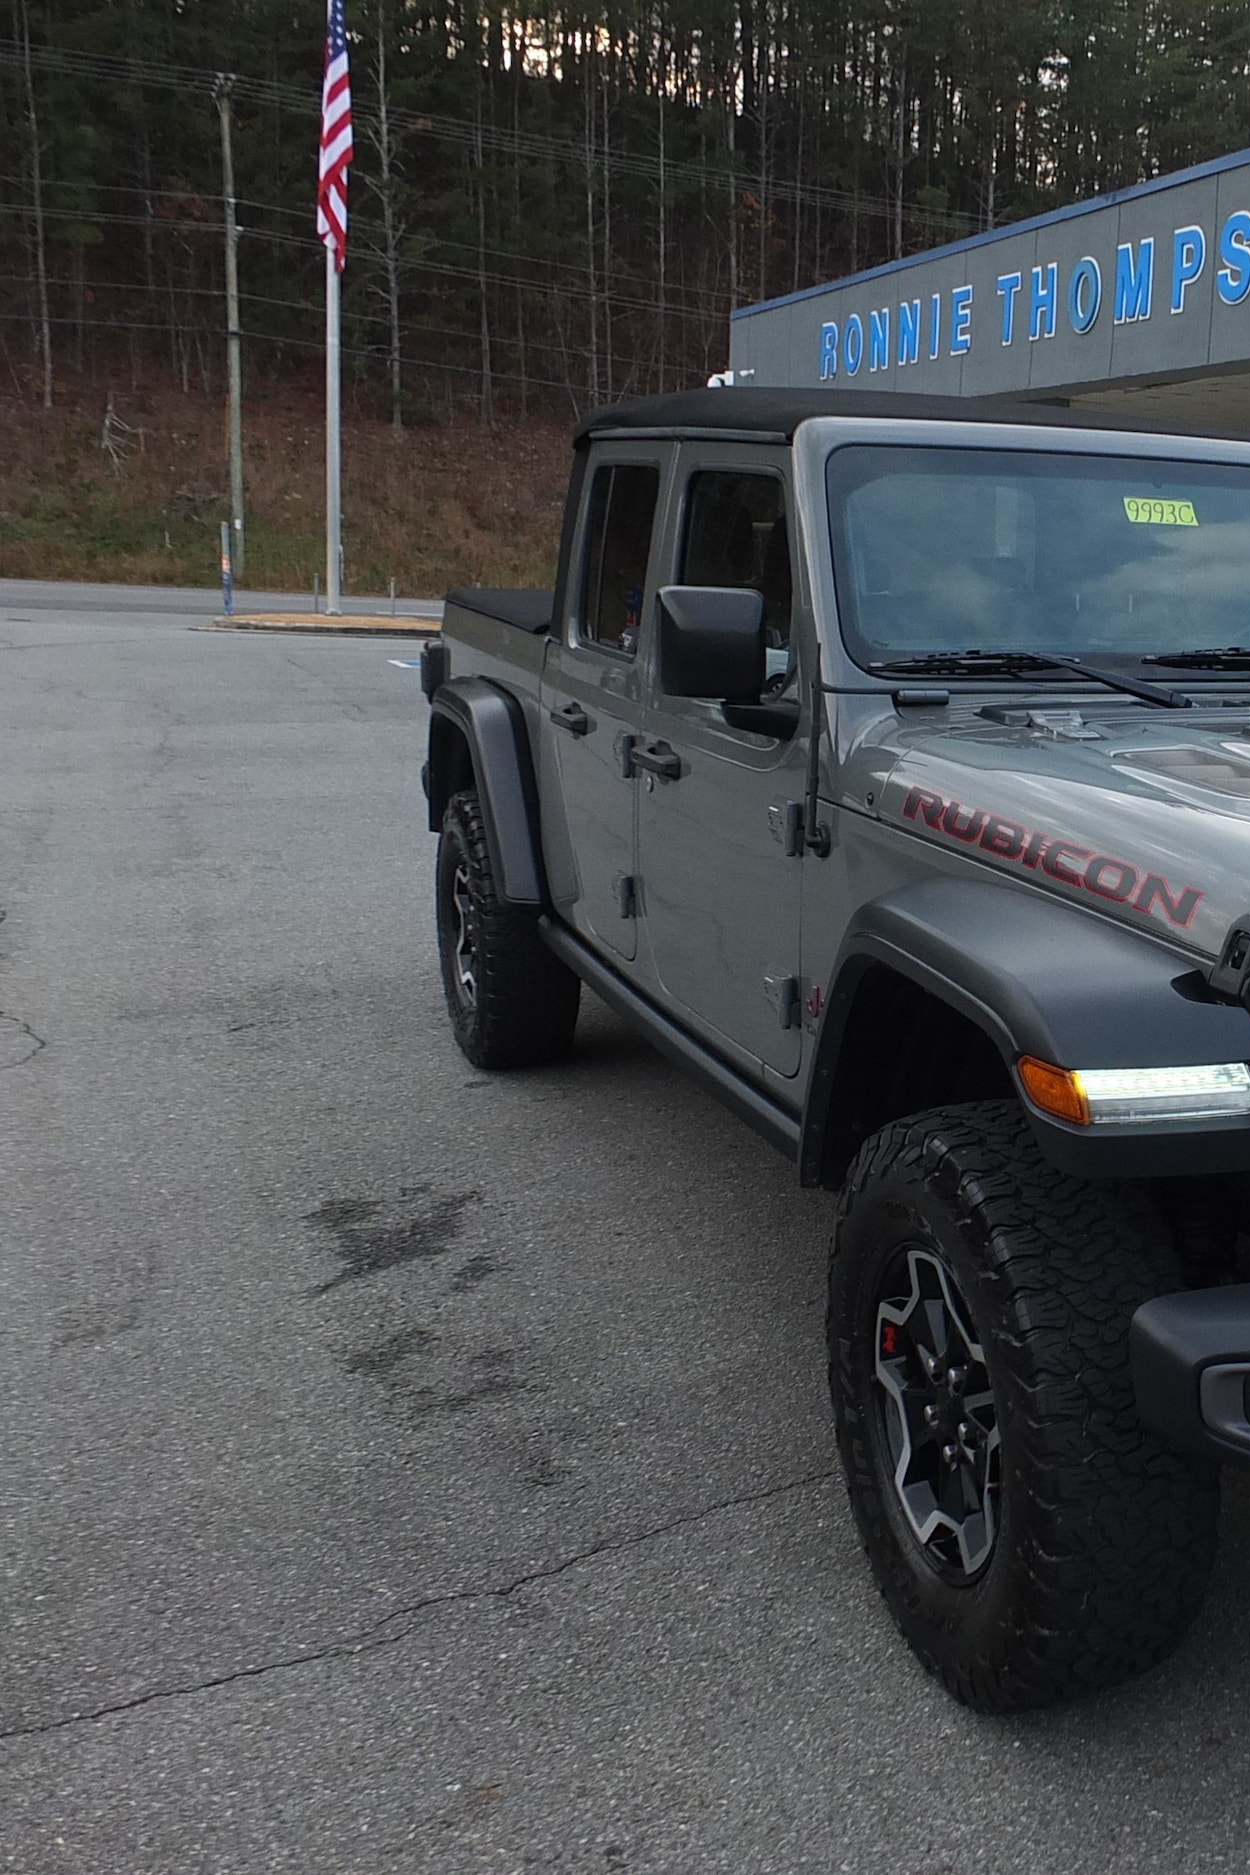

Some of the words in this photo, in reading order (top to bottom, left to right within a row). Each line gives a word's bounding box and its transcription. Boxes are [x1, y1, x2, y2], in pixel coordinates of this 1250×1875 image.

[820, 285, 973, 381] RONNIE
[1127, 500, 1194, 524] 9993C
[902, 786, 1205, 929] RUBICON
